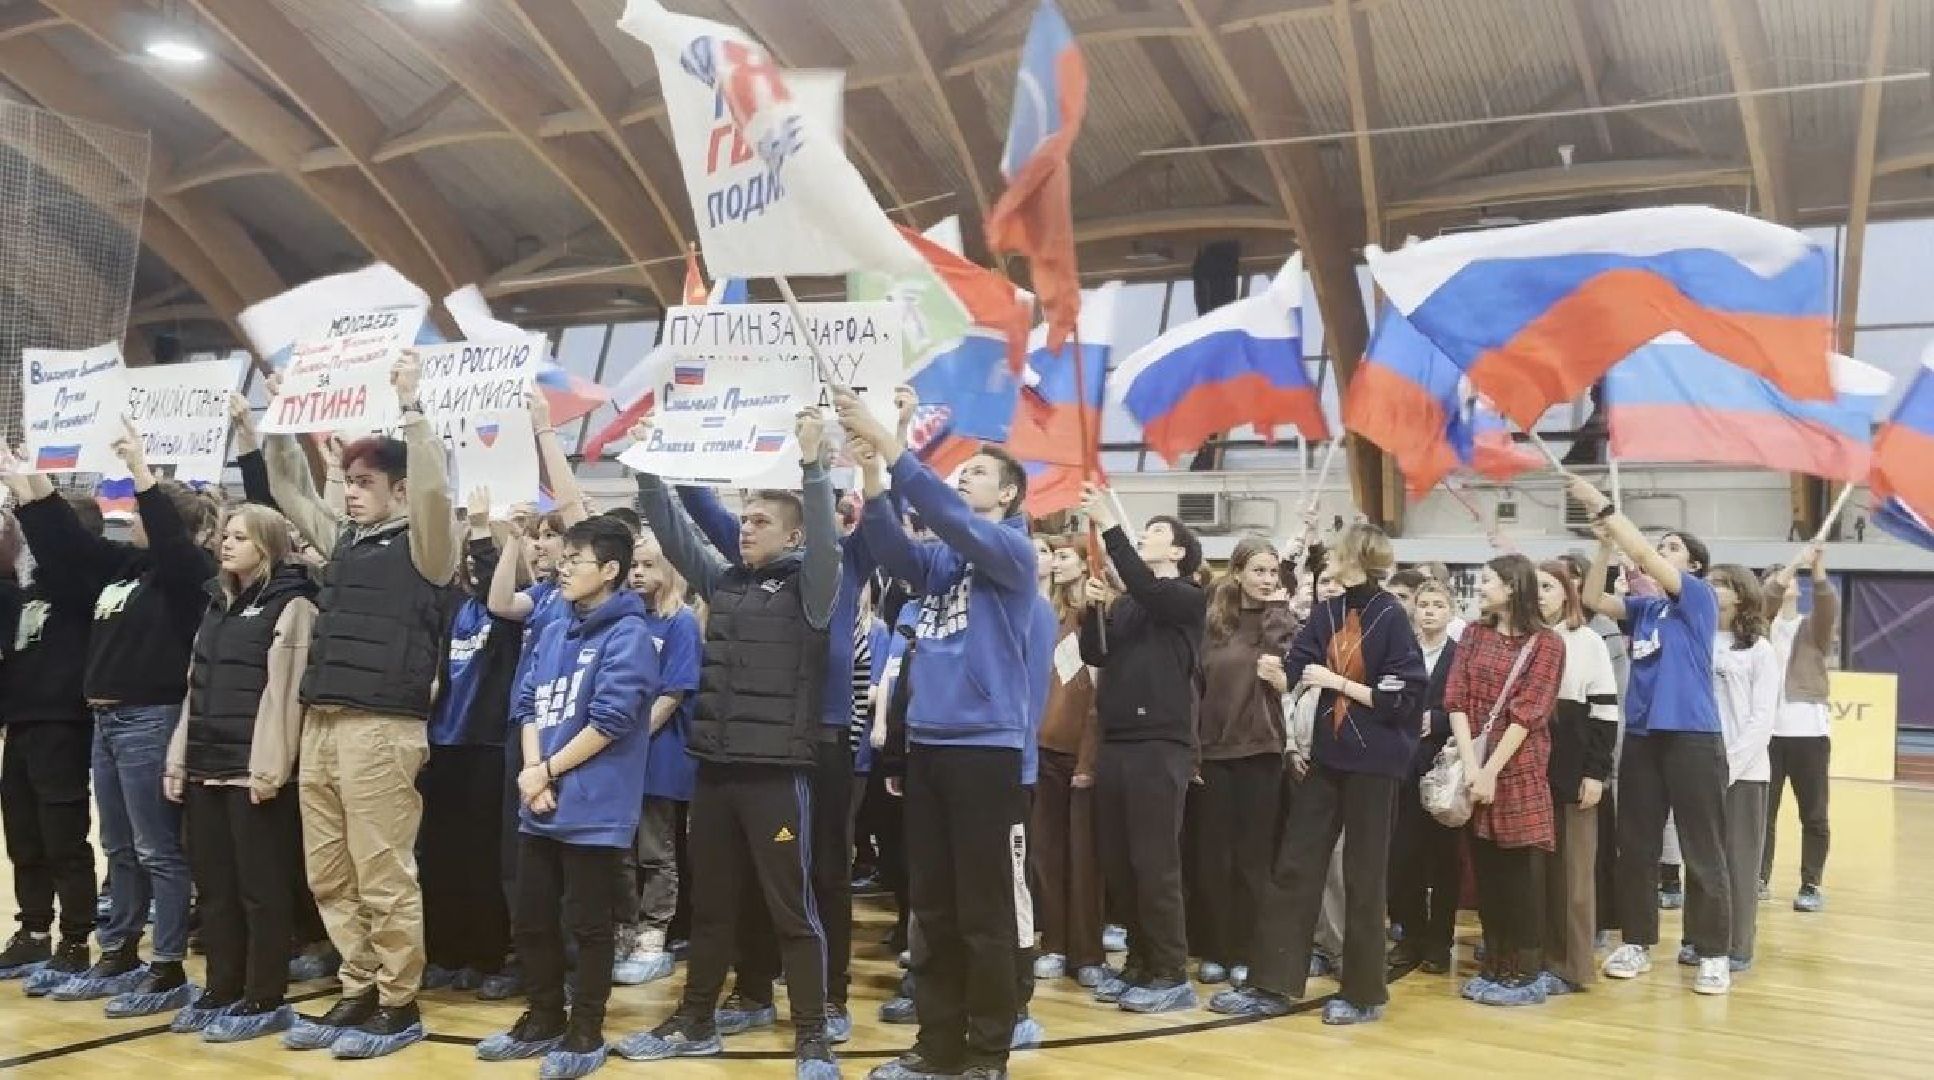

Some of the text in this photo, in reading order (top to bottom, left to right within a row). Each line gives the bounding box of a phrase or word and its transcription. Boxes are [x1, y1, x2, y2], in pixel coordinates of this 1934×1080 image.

[670, 311, 763, 346] ПУТИН
[768, 311, 797, 346] ЗА
[459, 344, 530, 376] РОССИЮ
[277, 384, 367, 425] ПУТИНА
[424, 377, 525, 413] АДИМИРА
